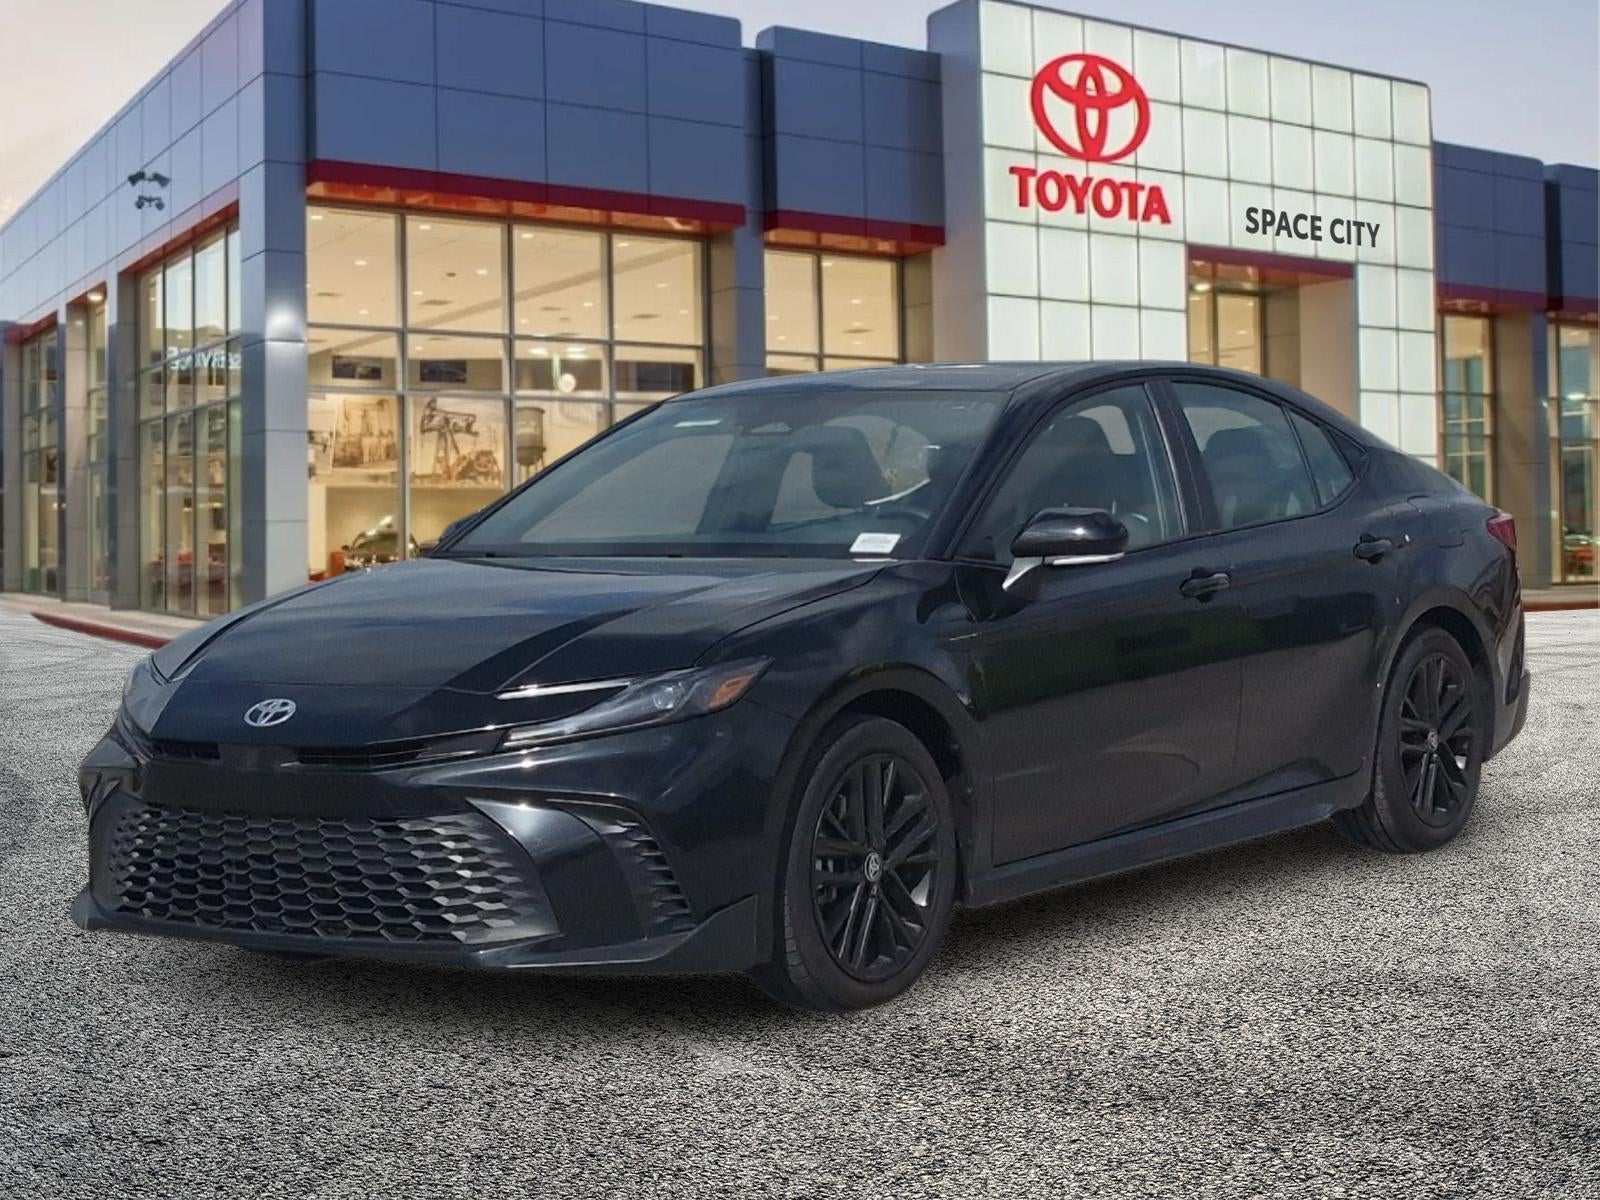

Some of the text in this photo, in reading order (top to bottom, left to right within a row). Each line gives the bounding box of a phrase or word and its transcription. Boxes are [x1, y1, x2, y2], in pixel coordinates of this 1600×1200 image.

[1009, 166, 1171, 225] TOYOTA
[1245, 206, 1381, 248] SPACE CITY
